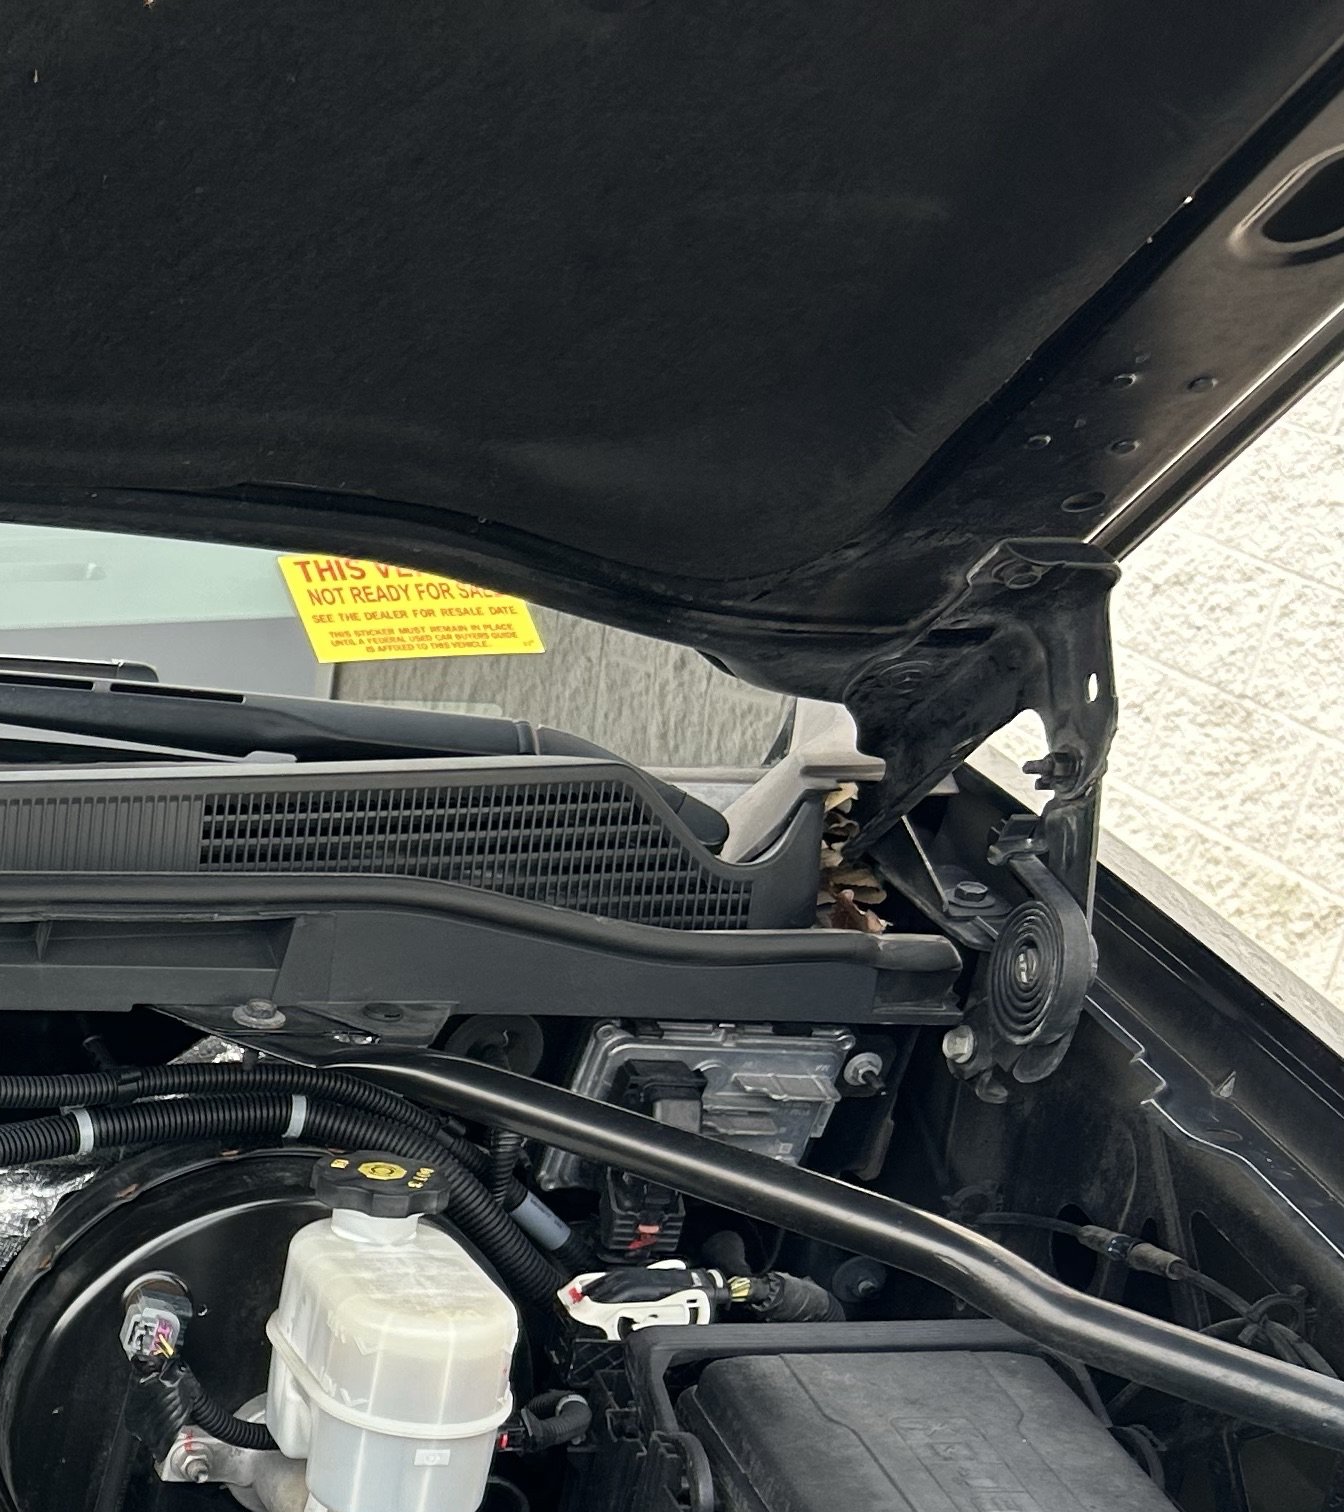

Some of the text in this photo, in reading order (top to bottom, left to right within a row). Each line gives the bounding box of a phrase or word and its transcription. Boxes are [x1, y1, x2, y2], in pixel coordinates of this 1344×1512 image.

[293, 559, 366, 583] THIS
[306, 588, 349, 607] NOT
[351, 584, 412, 605] READY
[415, 582, 454, 601] FOR
[311, 614, 334, 624] SEE
[339, 613, 361, 623] THE
[364, 610, 409, 621] DEALER
[412, 609, 436, 619] FOR
[441, 607, 485, 617] RESALE
[328, 630, 352, 639] THIS
[353, 627, 396, 638] STICKER
[397, 626, 426, 635] MUST
[429, 624, 468, 633] REMAIN
[408, 634, 433, 642] USED
